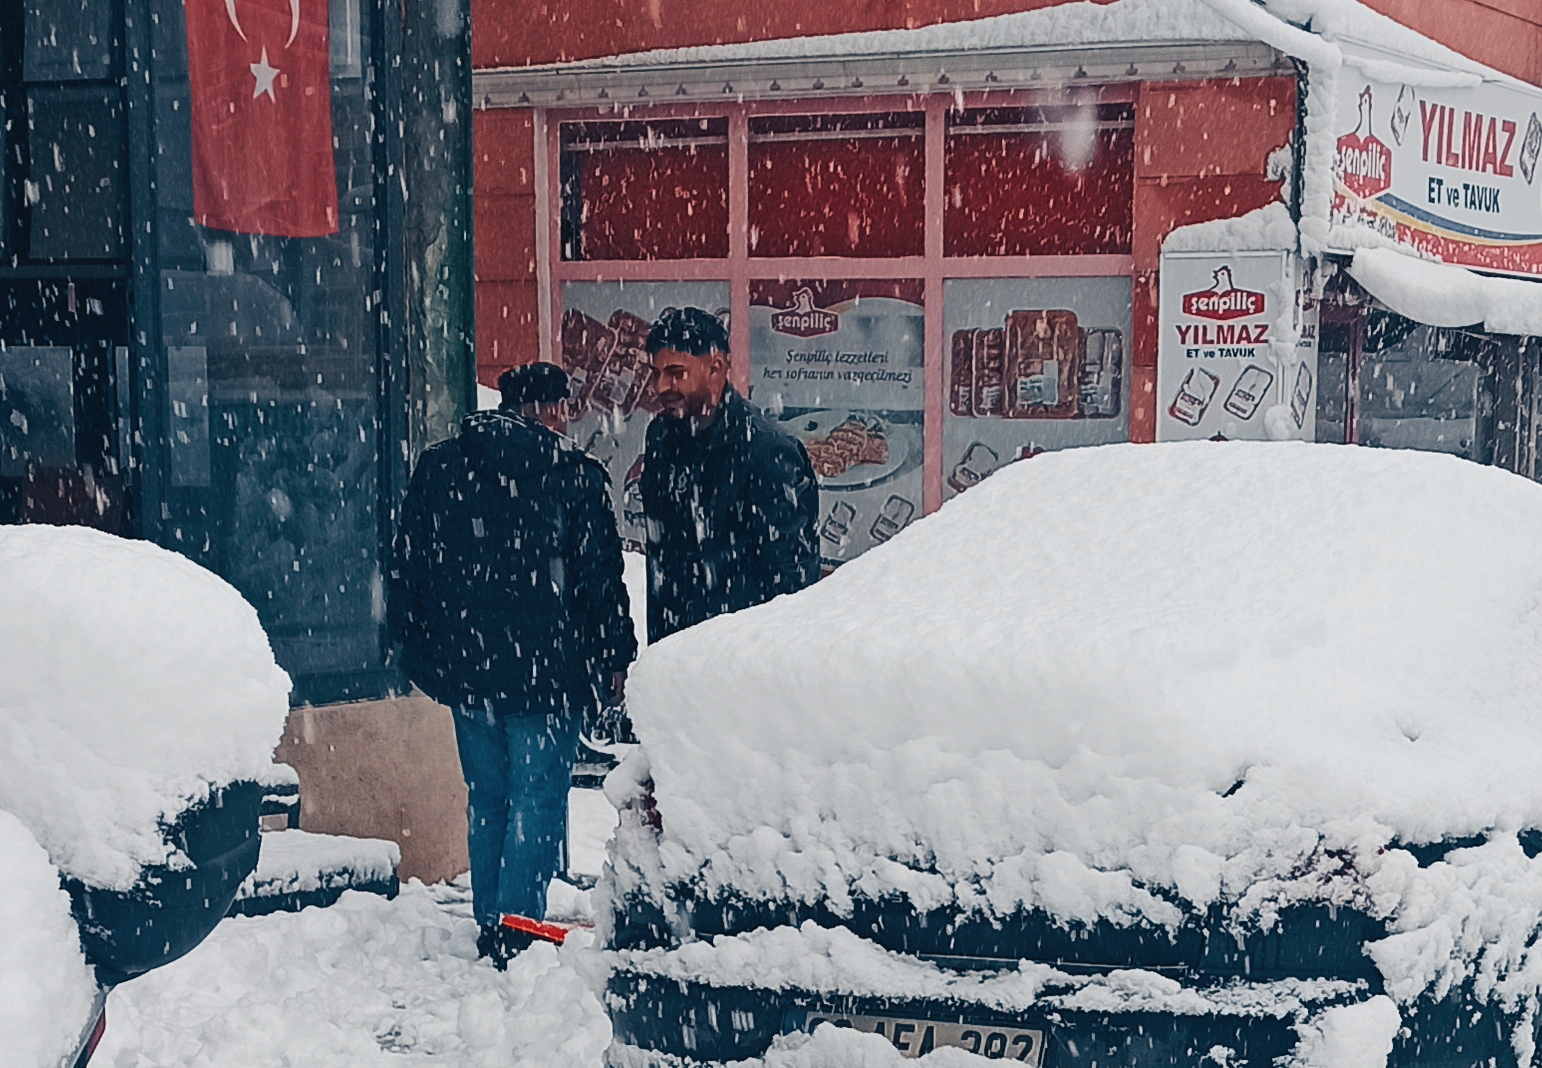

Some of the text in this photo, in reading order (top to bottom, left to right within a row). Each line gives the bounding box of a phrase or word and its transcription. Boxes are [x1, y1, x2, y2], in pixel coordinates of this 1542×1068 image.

[1419, 99, 1517, 178] YILMAZ
[1428, 176, 1500, 213] ET ve TAVUK
[1191, 291, 1256, 315] şenpiliç
[777, 315, 831, 332] şenpiliç
[1175, 324, 1270, 345] YILMAZ
[785, 349, 889, 366] Şenpiliç lezzetleri
[1186, 347, 1256, 358] ET ve TAVUK
[763, 367, 782, 379] her
